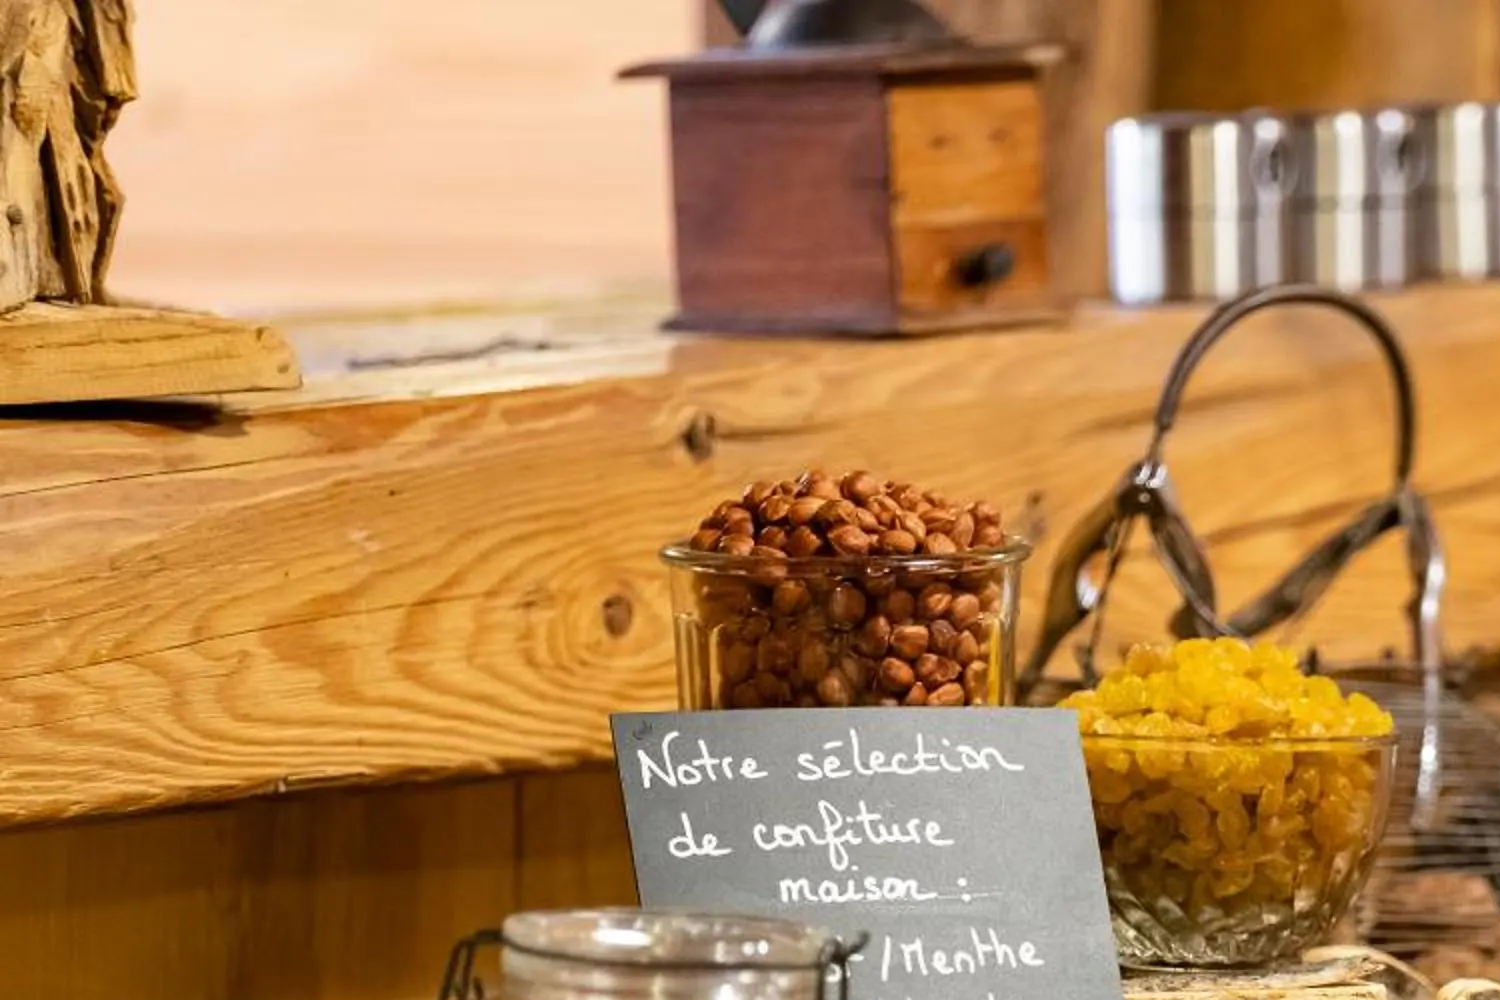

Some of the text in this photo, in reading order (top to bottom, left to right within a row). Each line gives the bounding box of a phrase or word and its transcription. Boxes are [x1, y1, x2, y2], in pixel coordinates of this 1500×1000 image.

[637, 728, 1025, 788] Notre sélection
[668, 800, 955, 871] de confiture
